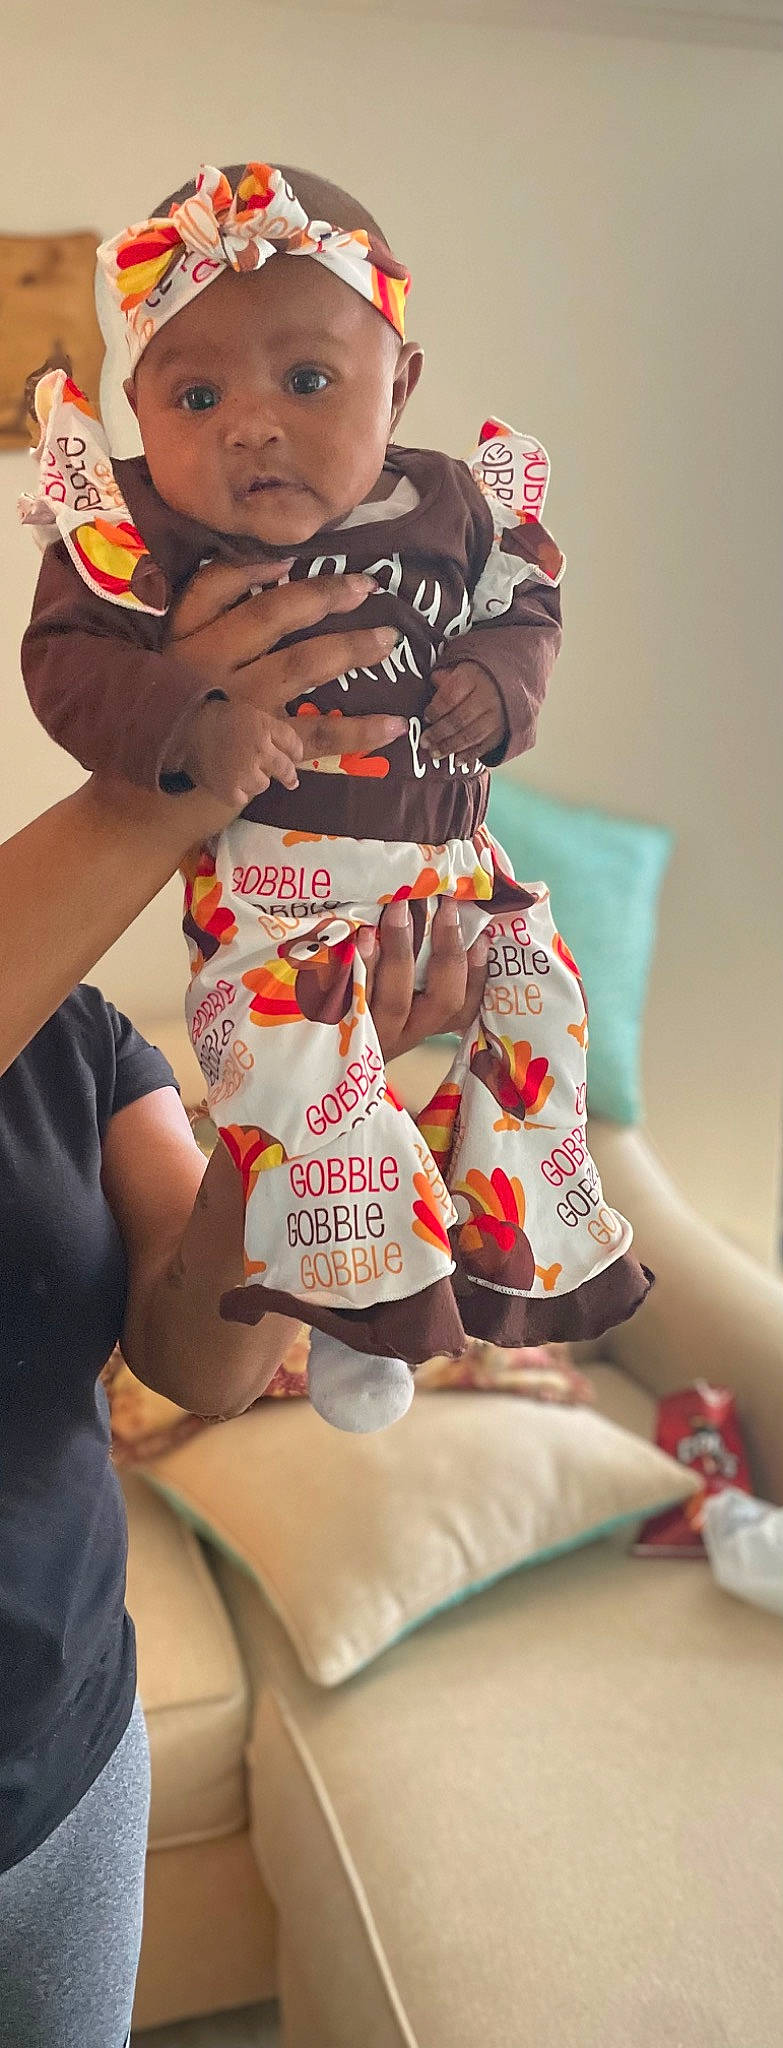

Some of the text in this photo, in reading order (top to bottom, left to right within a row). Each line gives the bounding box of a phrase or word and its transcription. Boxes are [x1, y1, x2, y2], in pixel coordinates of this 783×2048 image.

[487, 945, 550, 978] BBLe
[289, 1155, 400, 1198] GOBBLe
[540, 1125, 588, 1187] GOBB
[286, 1202, 386, 1248] GOBBLe
[300, 1241, 403, 1290] GOBBLe
